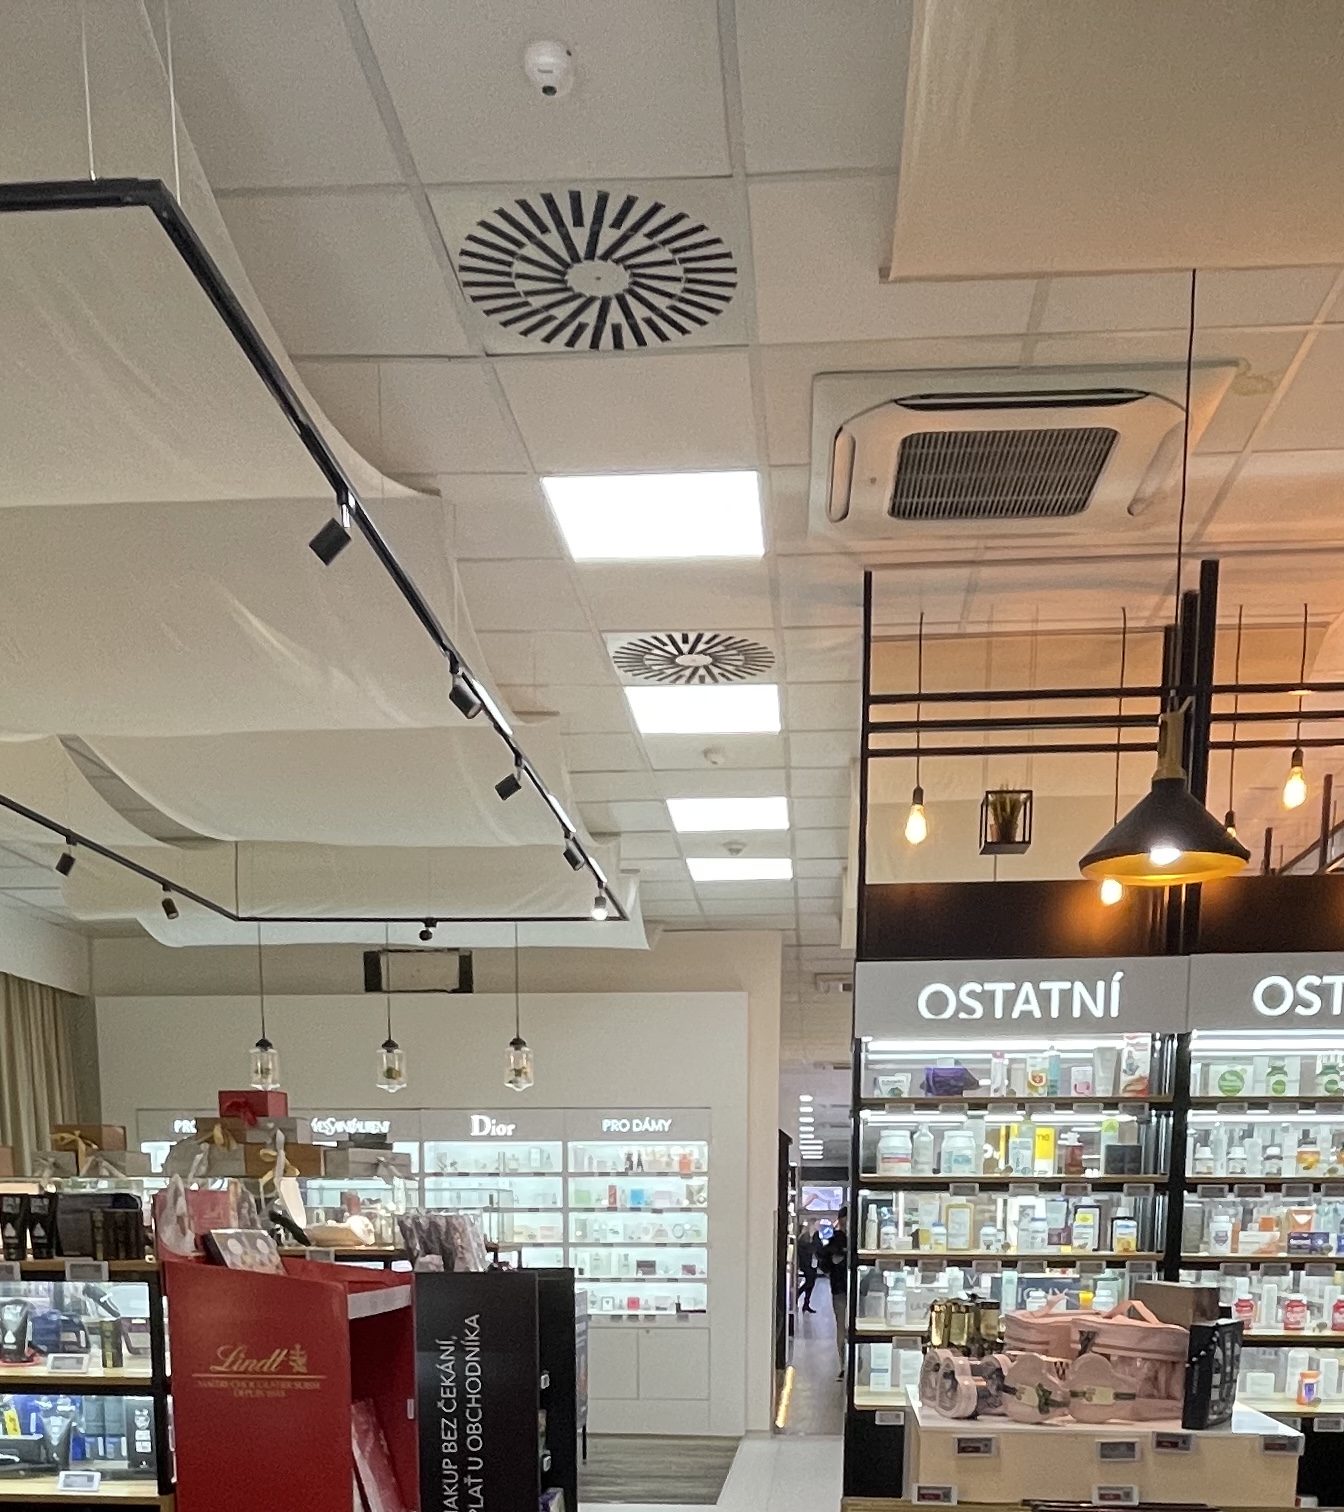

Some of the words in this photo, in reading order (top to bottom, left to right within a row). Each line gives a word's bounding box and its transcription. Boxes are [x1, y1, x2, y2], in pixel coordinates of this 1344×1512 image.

[917, 970, 1125, 1020] OSTATNÍ
[470, 1114, 516, 1137] Dior
[602, 1118, 631, 1132] PRO
[633, 1116, 672, 1133] DÁMY
[209, 1344, 289, 1374] Lindt
[435, 1335, 459, 1414] ČEKÁNÍ,
[460, 1313, 484, 1452] OBCHODNÍKA
[441, 1416, 458, 1454] BEZ
[467, 1456, 484, 1471] U
